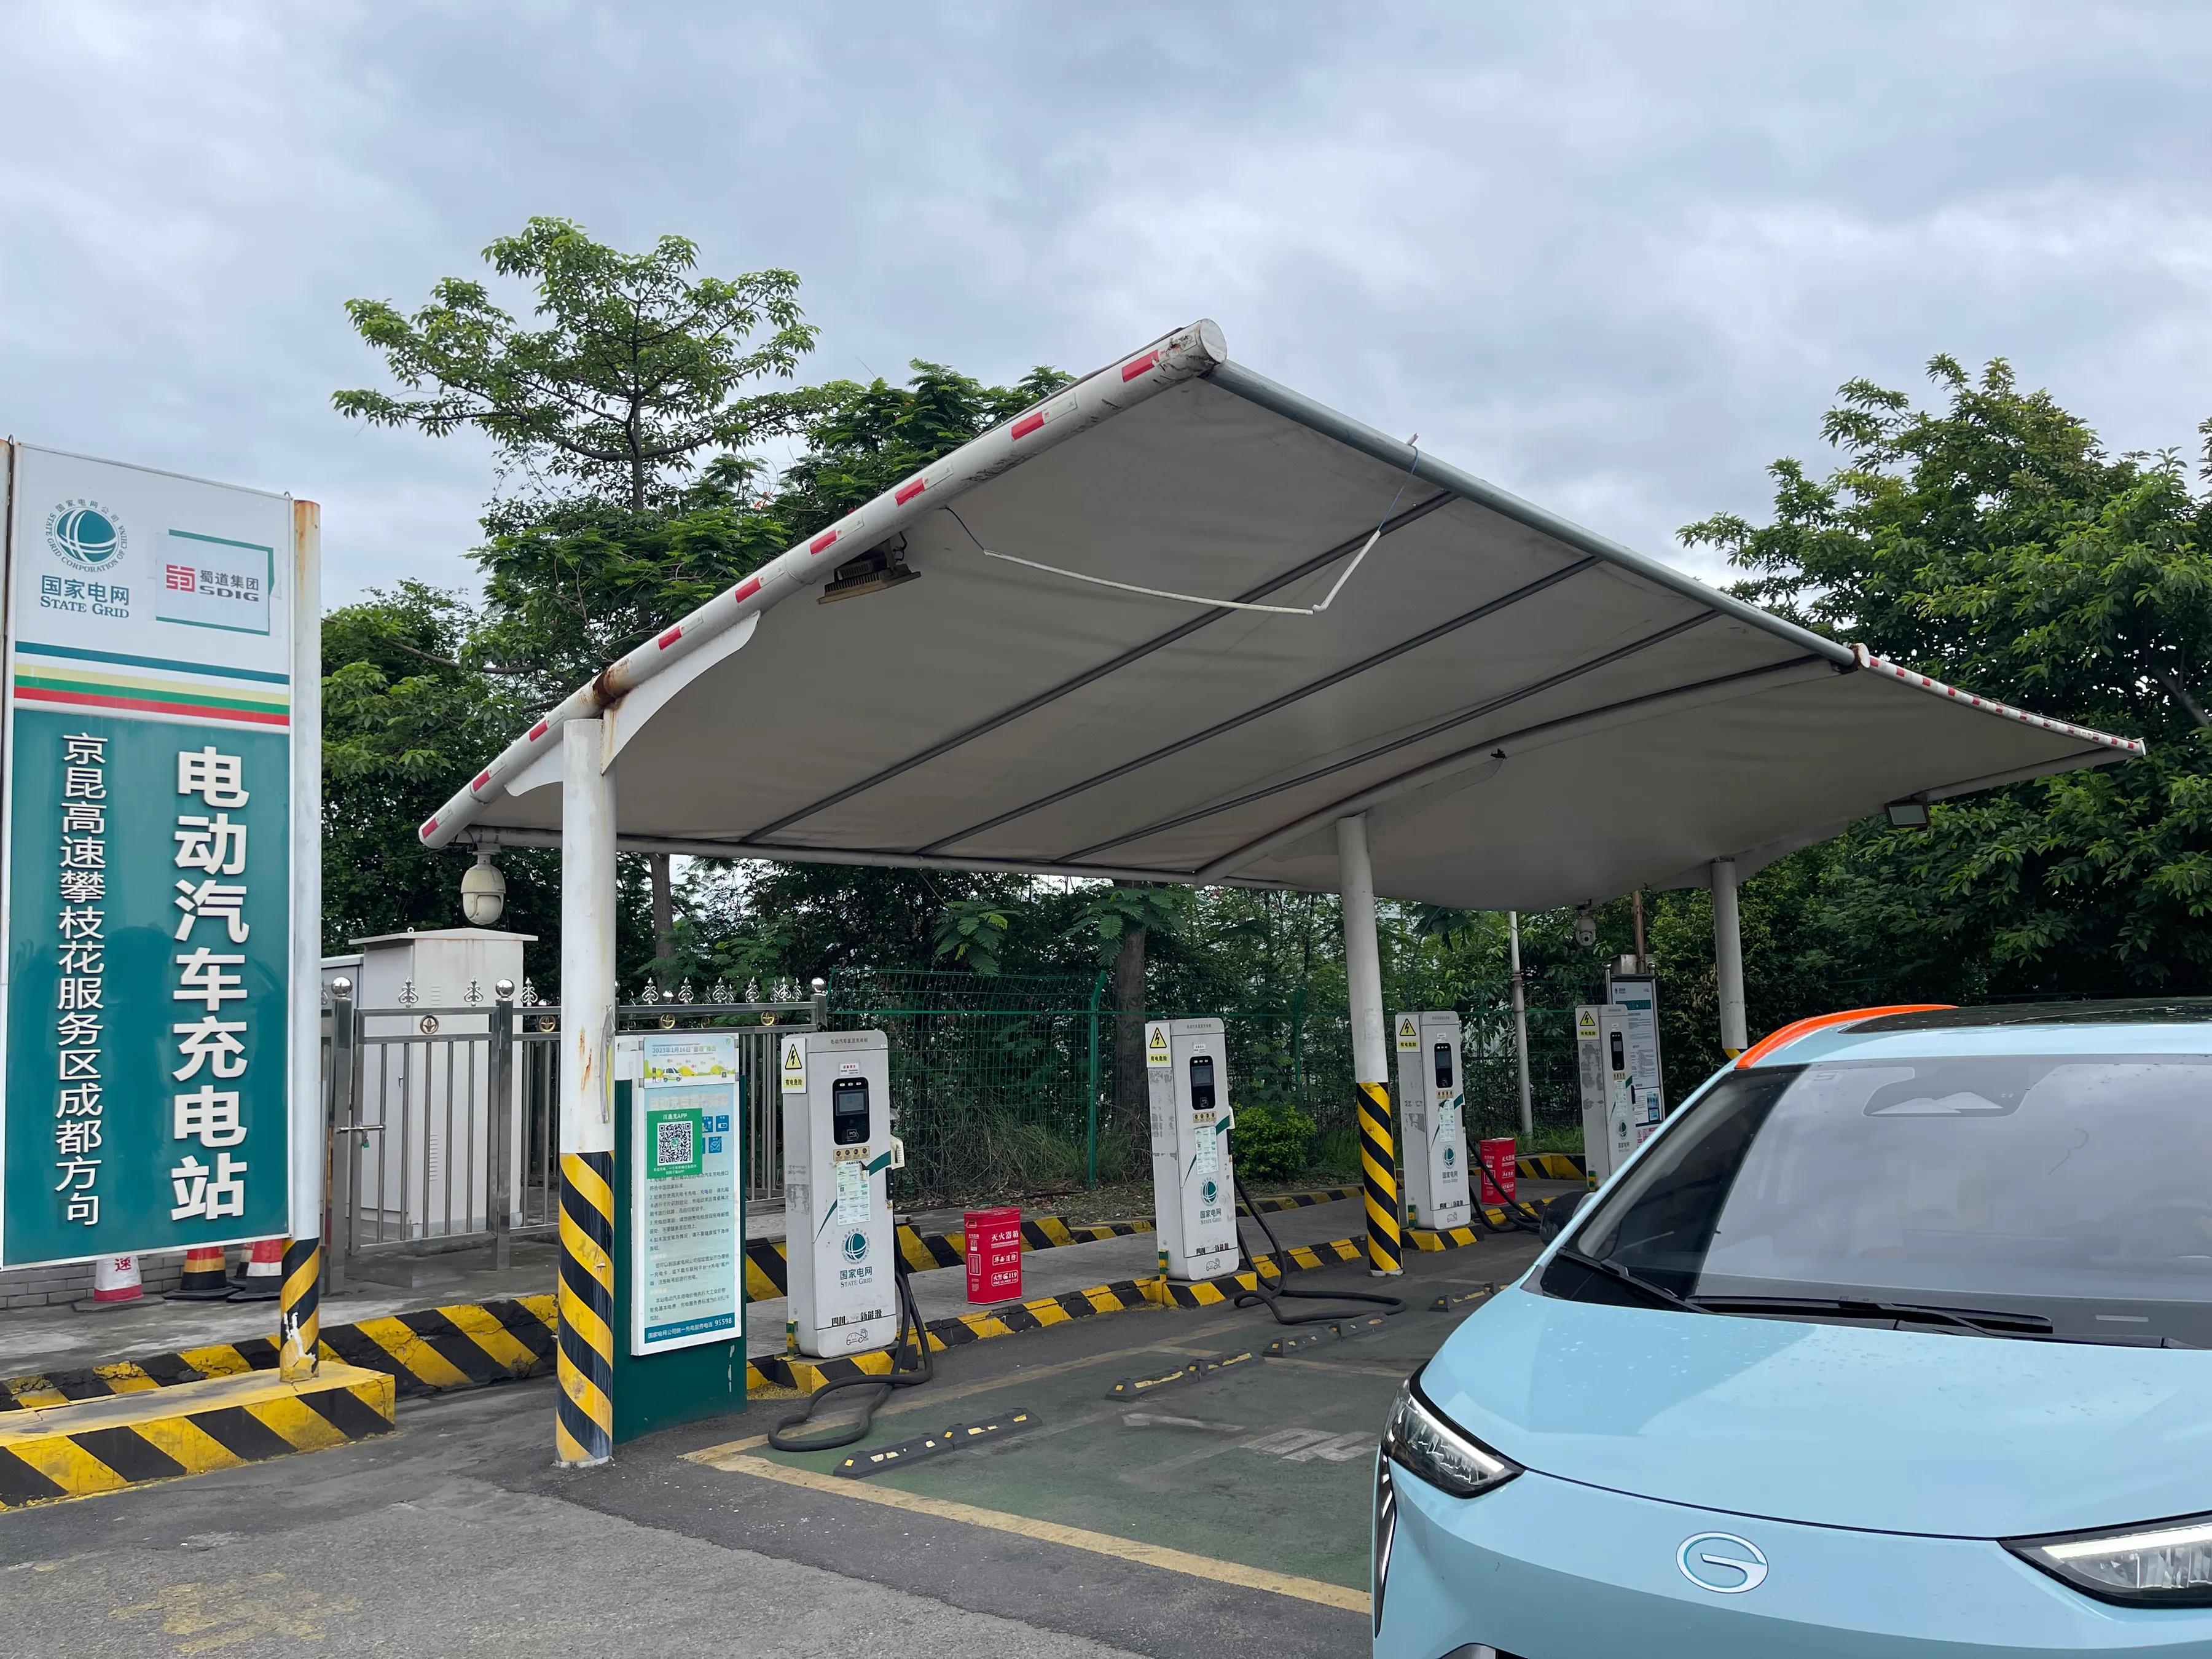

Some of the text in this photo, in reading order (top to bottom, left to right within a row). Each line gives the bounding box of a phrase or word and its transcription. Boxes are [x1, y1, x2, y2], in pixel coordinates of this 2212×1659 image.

[200, 570, 259, 590] 蜀道集团
[42, 575, 129, 606] 国家电网
[199, 586, 259, 602] SDIG
[171, 745, 249, 1222] 电动汽车充电站
[1200, 1208, 1222, 1218] 国家电网
[992, 1231, 1019, 1242] 灭火器箱
[840, 1266, 873, 1280] 国家电网
[715, 1317, 732, 1327] 95598
